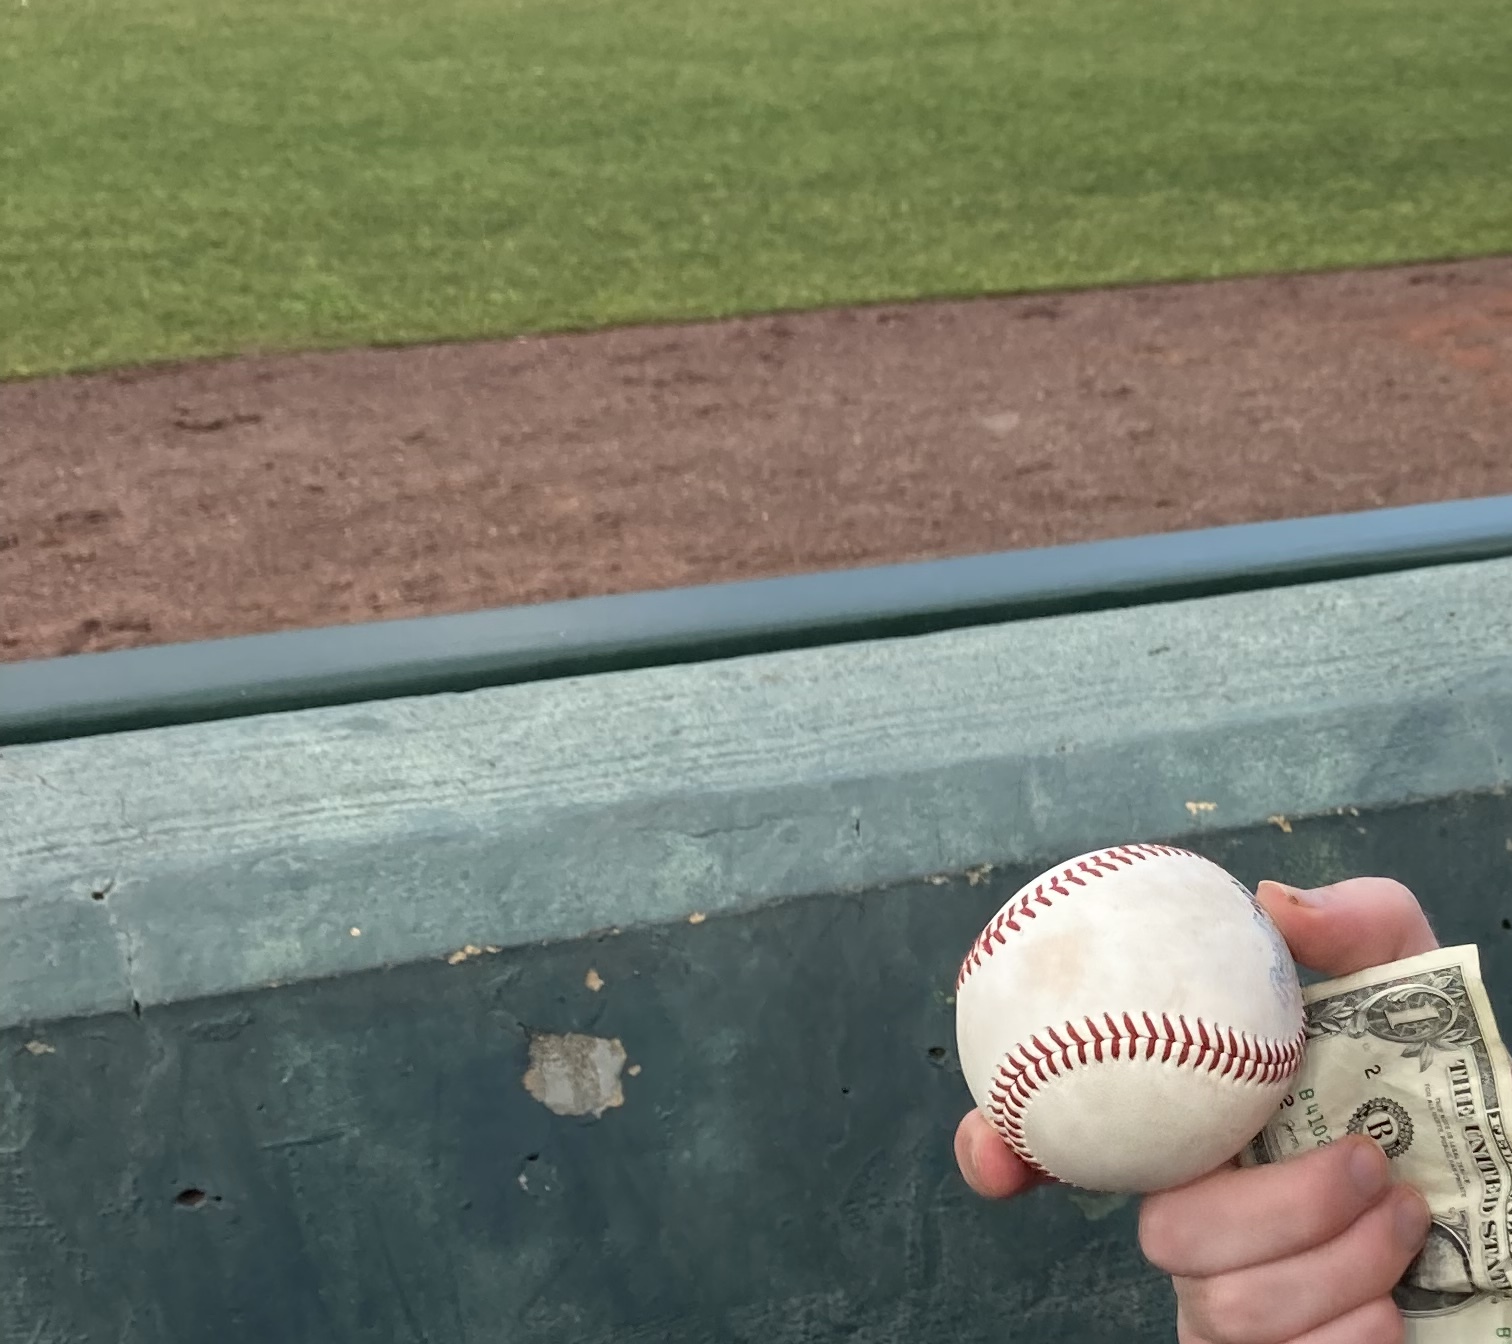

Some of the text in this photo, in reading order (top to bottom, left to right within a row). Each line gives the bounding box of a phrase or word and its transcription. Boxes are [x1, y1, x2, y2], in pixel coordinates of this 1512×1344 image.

[1383, 1006, 1440, 1031] 1
[1364, 1063, 1382, 1081] 2
[1365, 1115, 1395, 1142] B
[1449, 1058, 1476, 1119] THE
[1465, 1124, 1502, 1214] UNITED
